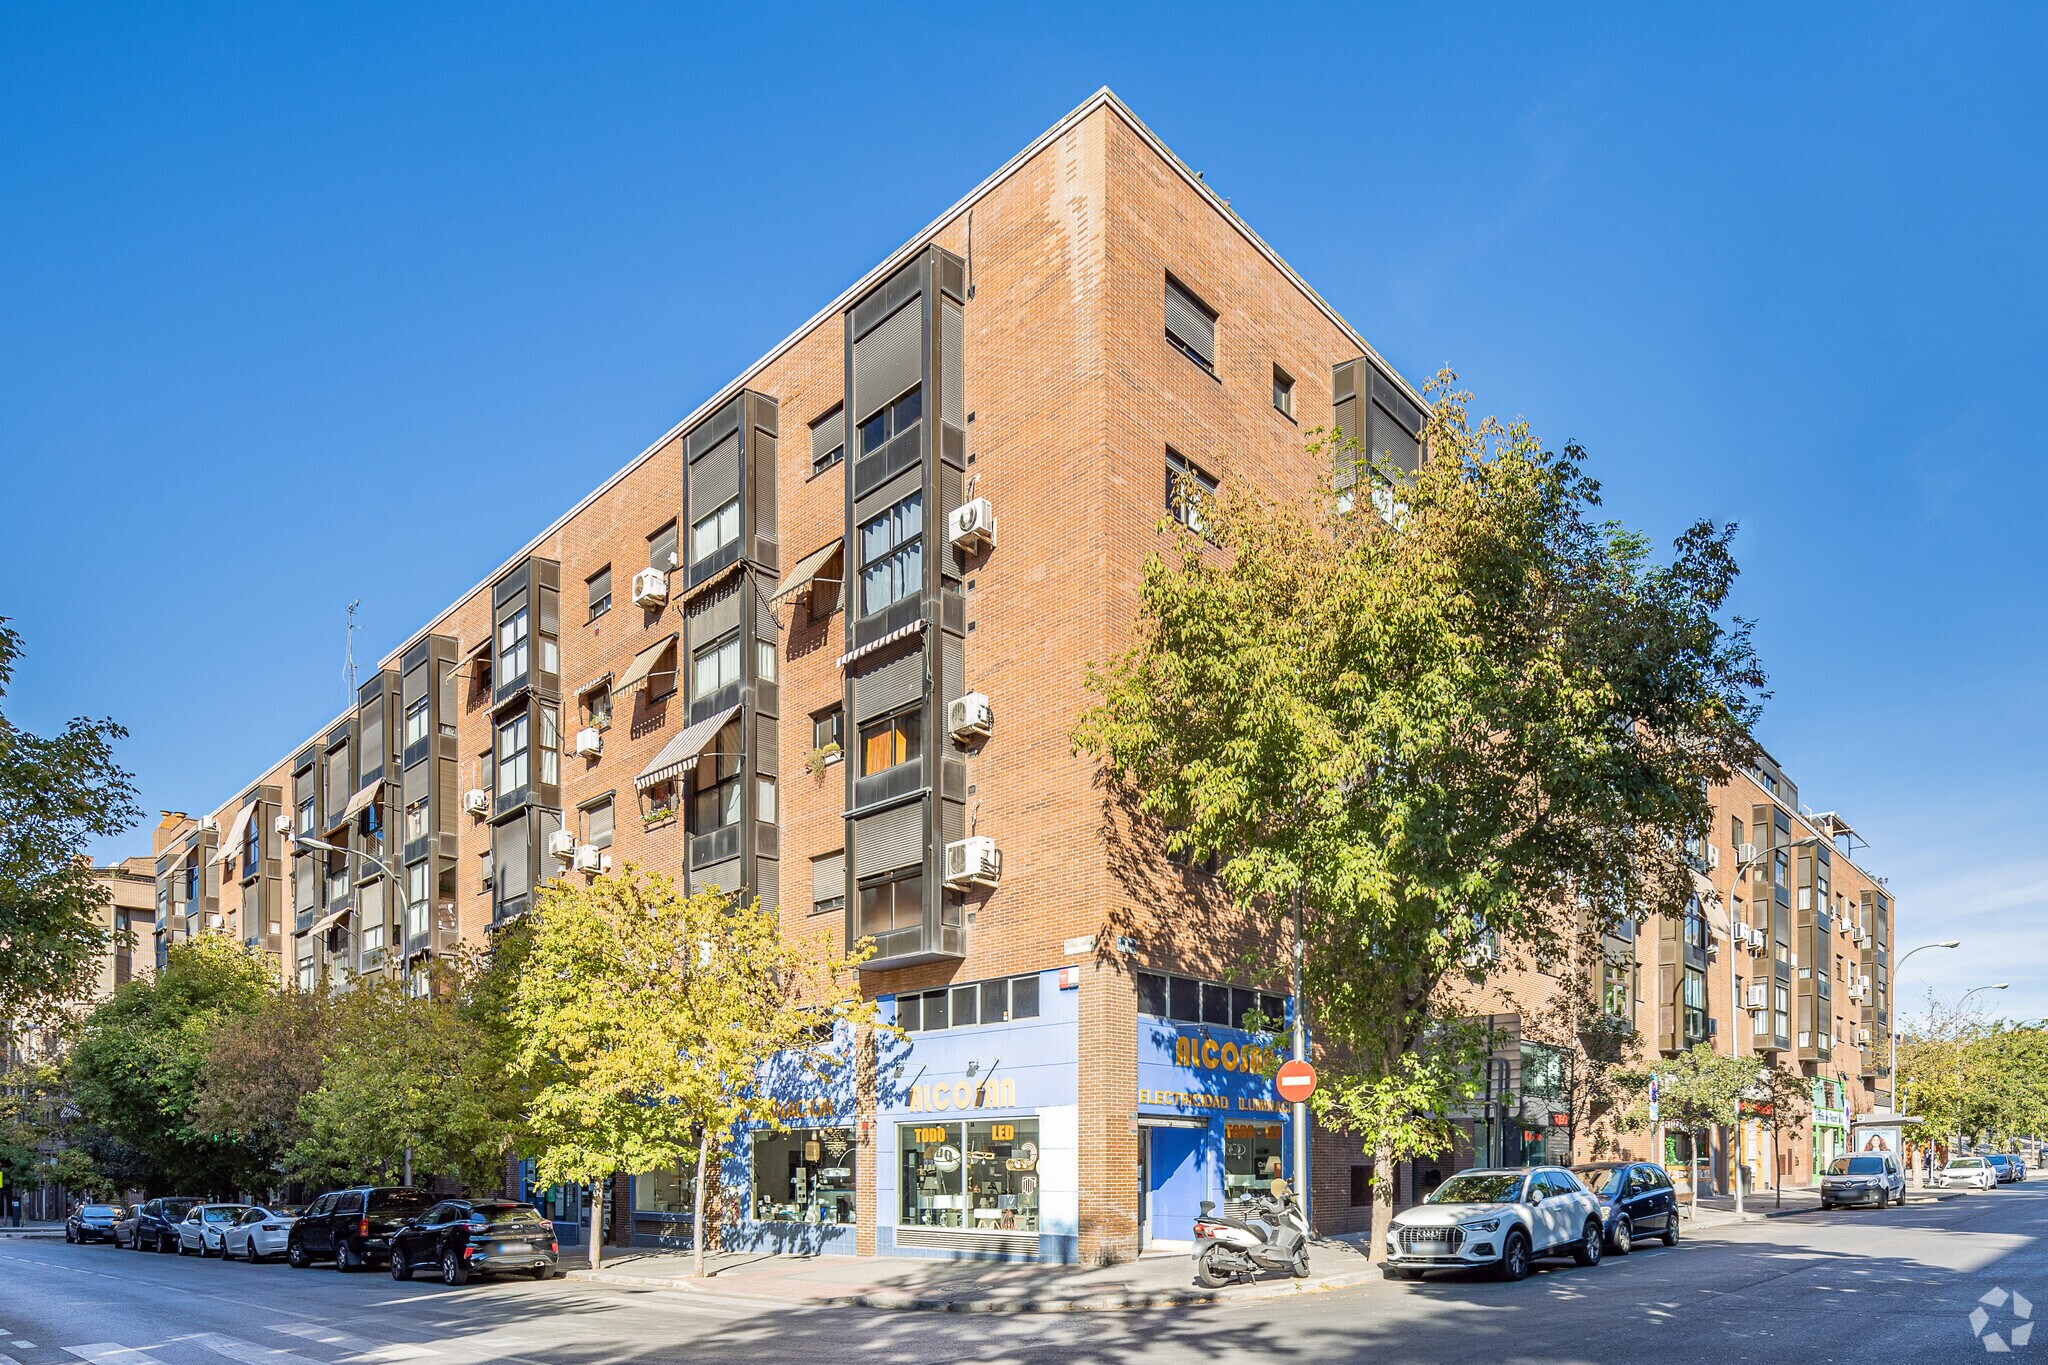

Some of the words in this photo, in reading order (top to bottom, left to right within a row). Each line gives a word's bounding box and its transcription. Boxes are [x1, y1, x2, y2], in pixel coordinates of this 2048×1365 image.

[1139, 1089, 1229, 1109] ELECTRICIDAD
[914, 1127, 947, 1143] TODO
[991, 1124, 1015, 1141] LED
